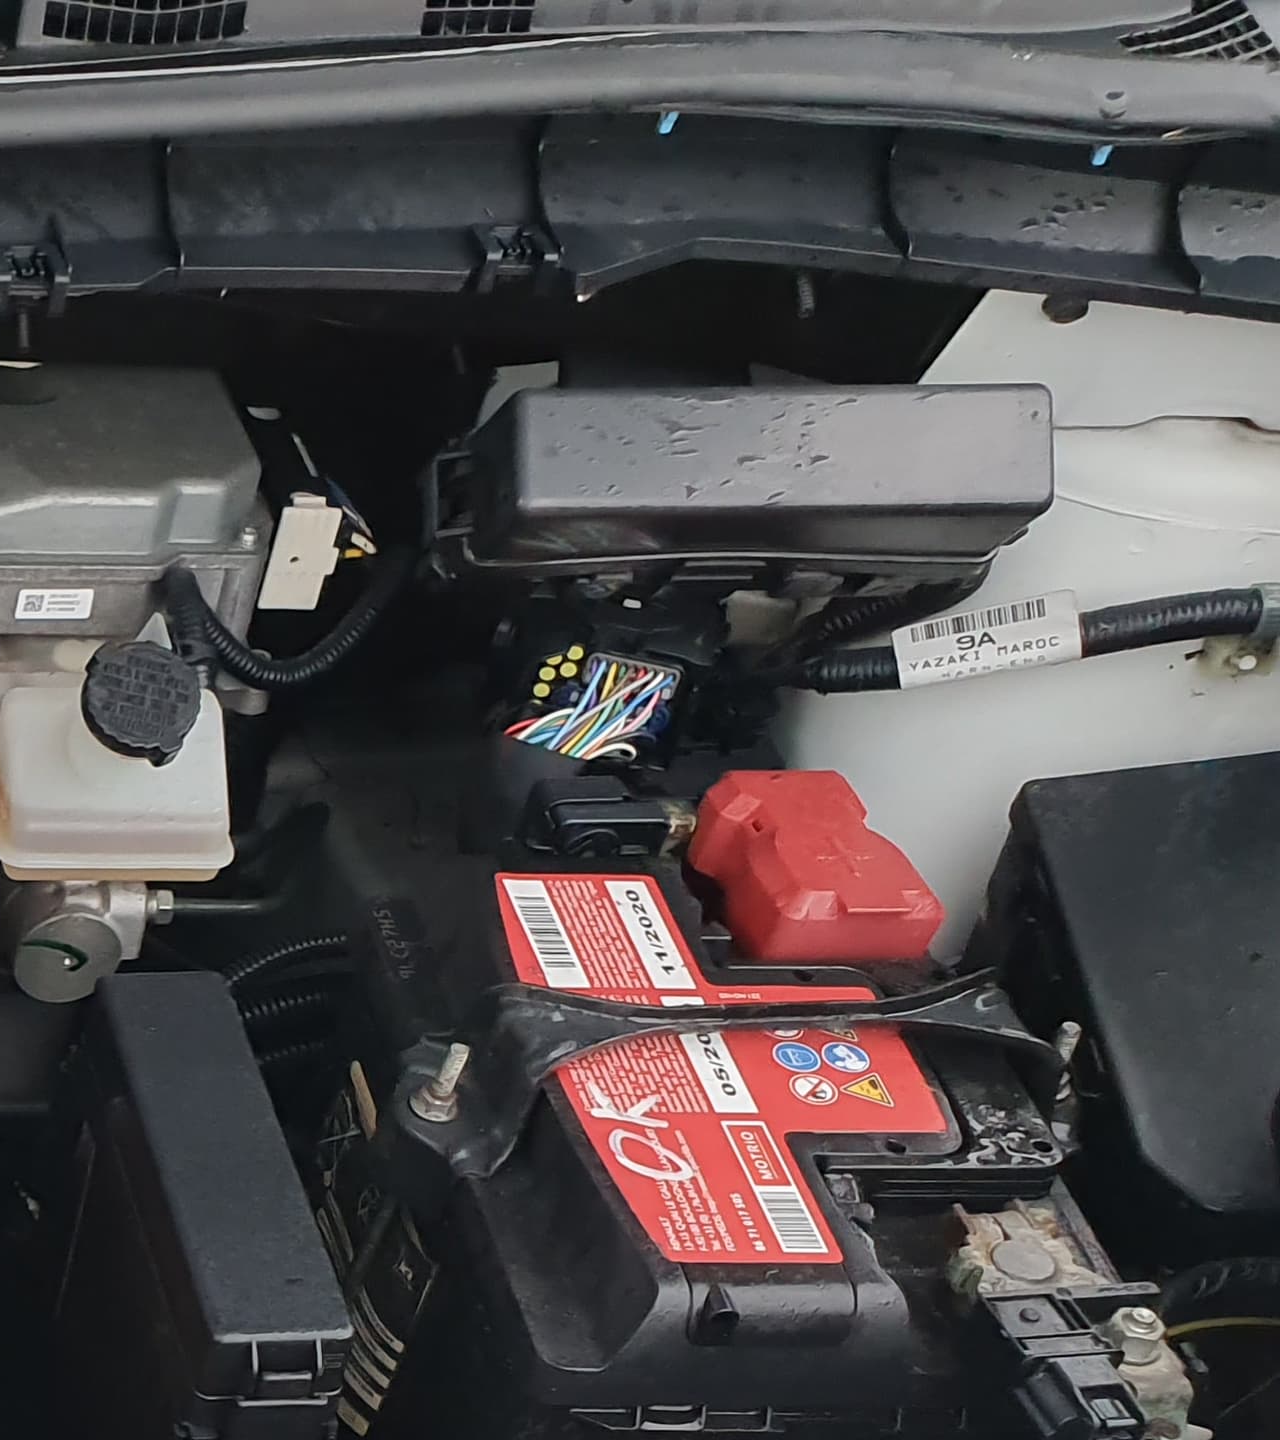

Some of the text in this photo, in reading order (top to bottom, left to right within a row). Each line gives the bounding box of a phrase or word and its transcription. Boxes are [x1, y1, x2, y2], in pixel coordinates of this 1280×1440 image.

[909, 635, 1060, 672] YAZAKI MAROC
[956, 631, 997, 651] 9A
[625, 889, 676, 976] 11/2020
[696, 1033, 737, 1096] 05/20
[587, 1082, 696, 1182] OK
[740, 1131, 774, 1180] MOTRIO
